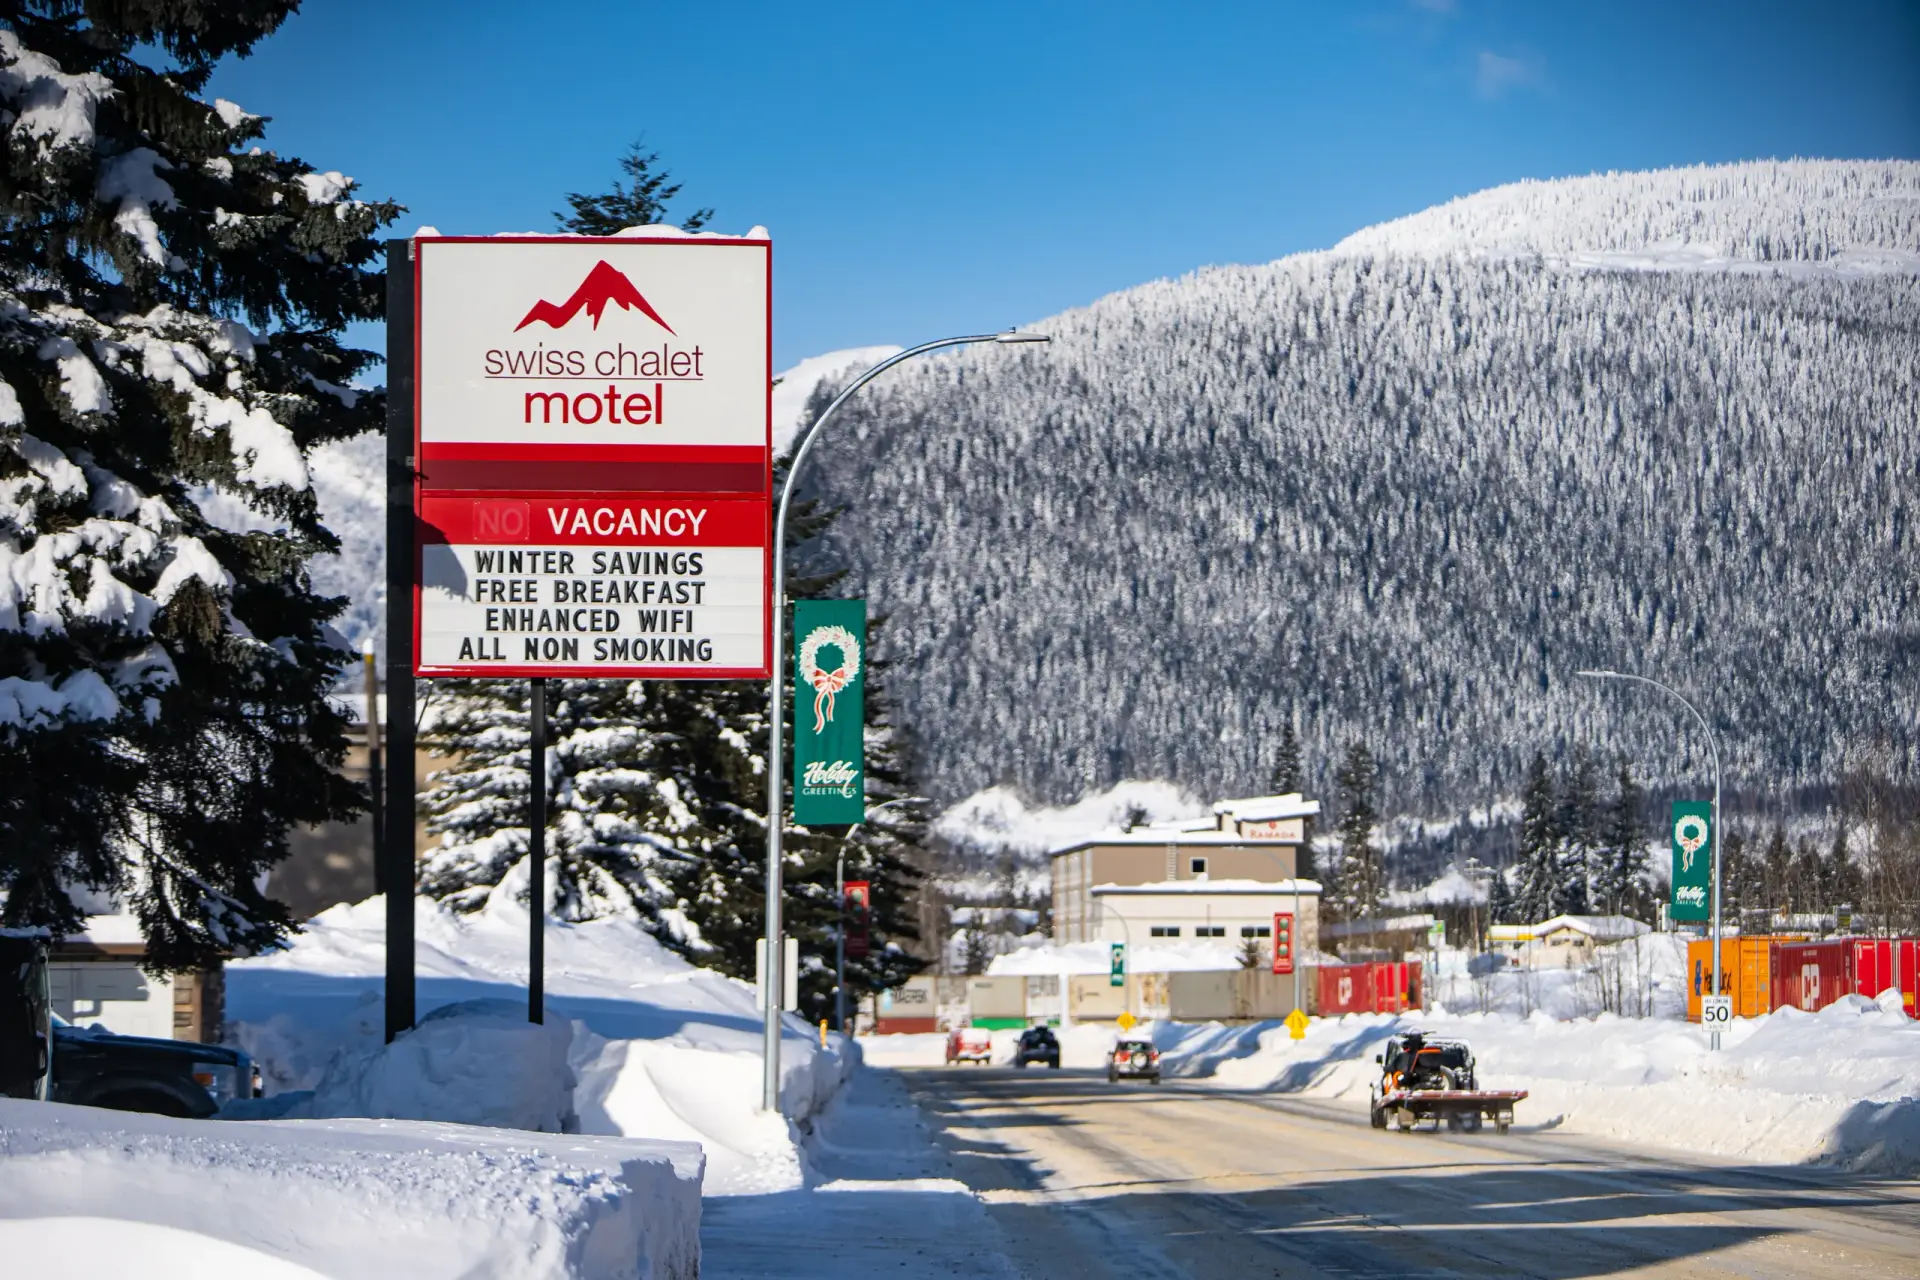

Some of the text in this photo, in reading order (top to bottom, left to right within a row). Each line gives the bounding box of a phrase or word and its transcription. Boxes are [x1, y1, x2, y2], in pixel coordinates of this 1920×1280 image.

[484, 342, 704, 377] swiss chalet
[524, 383, 663, 425] motel
[479, 507, 707, 536] NO VACANCY
[474, 550, 703, 576] WINTER SAVINGS
[475, 579, 706, 605] FREE BREAKFAST
[485, 608, 694, 633] ENHANCED WIFI
[458, 637, 713, 662] ALL NON SMOKING
[803, 760, 859, 798] Holiday
[1801, 964, 1819, 1011] CP
[1705, 1006, 1728, 1022] 50
